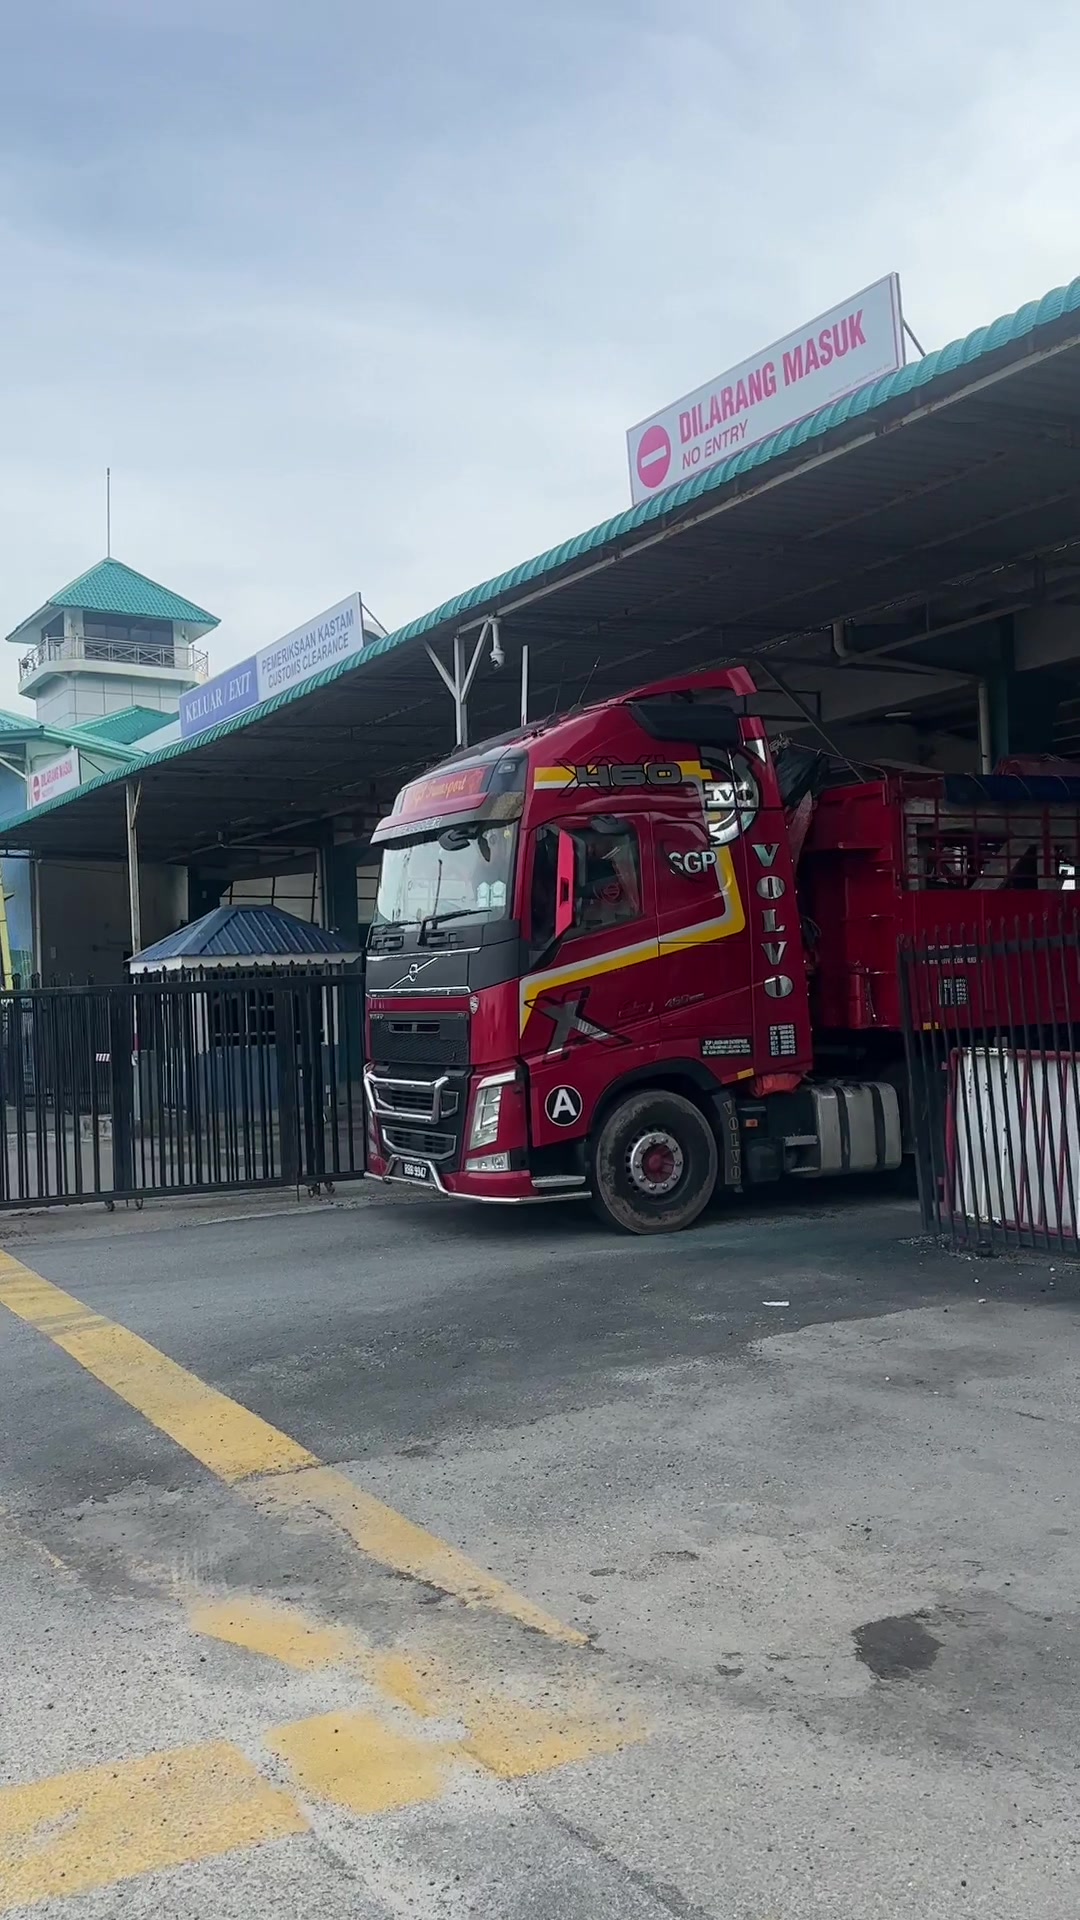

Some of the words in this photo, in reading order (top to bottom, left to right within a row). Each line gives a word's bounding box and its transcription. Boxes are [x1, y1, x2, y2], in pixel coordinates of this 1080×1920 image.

[679, 361, 777, 444] DILARANG
[782, 309, 867, 387] MASUK
[682, 445, 700, 470] NO
[704, 418, 748, 459] ENTRY
[261, 636, 317, 675] PEMERIKSAAN
[317, 609, 354, 640] KASTAM
[267, 659, 302, 689] CUSTOMS
[302, 632, 350, 671] CLEARANCE
[185, 686, 223, 724] KELUAR
[228, 671, 252, 702] EXIT
[576, 762, 682, 787] 460
[669, 850, 717, 875] SGP
[552, 1088, 577, 1119] A
